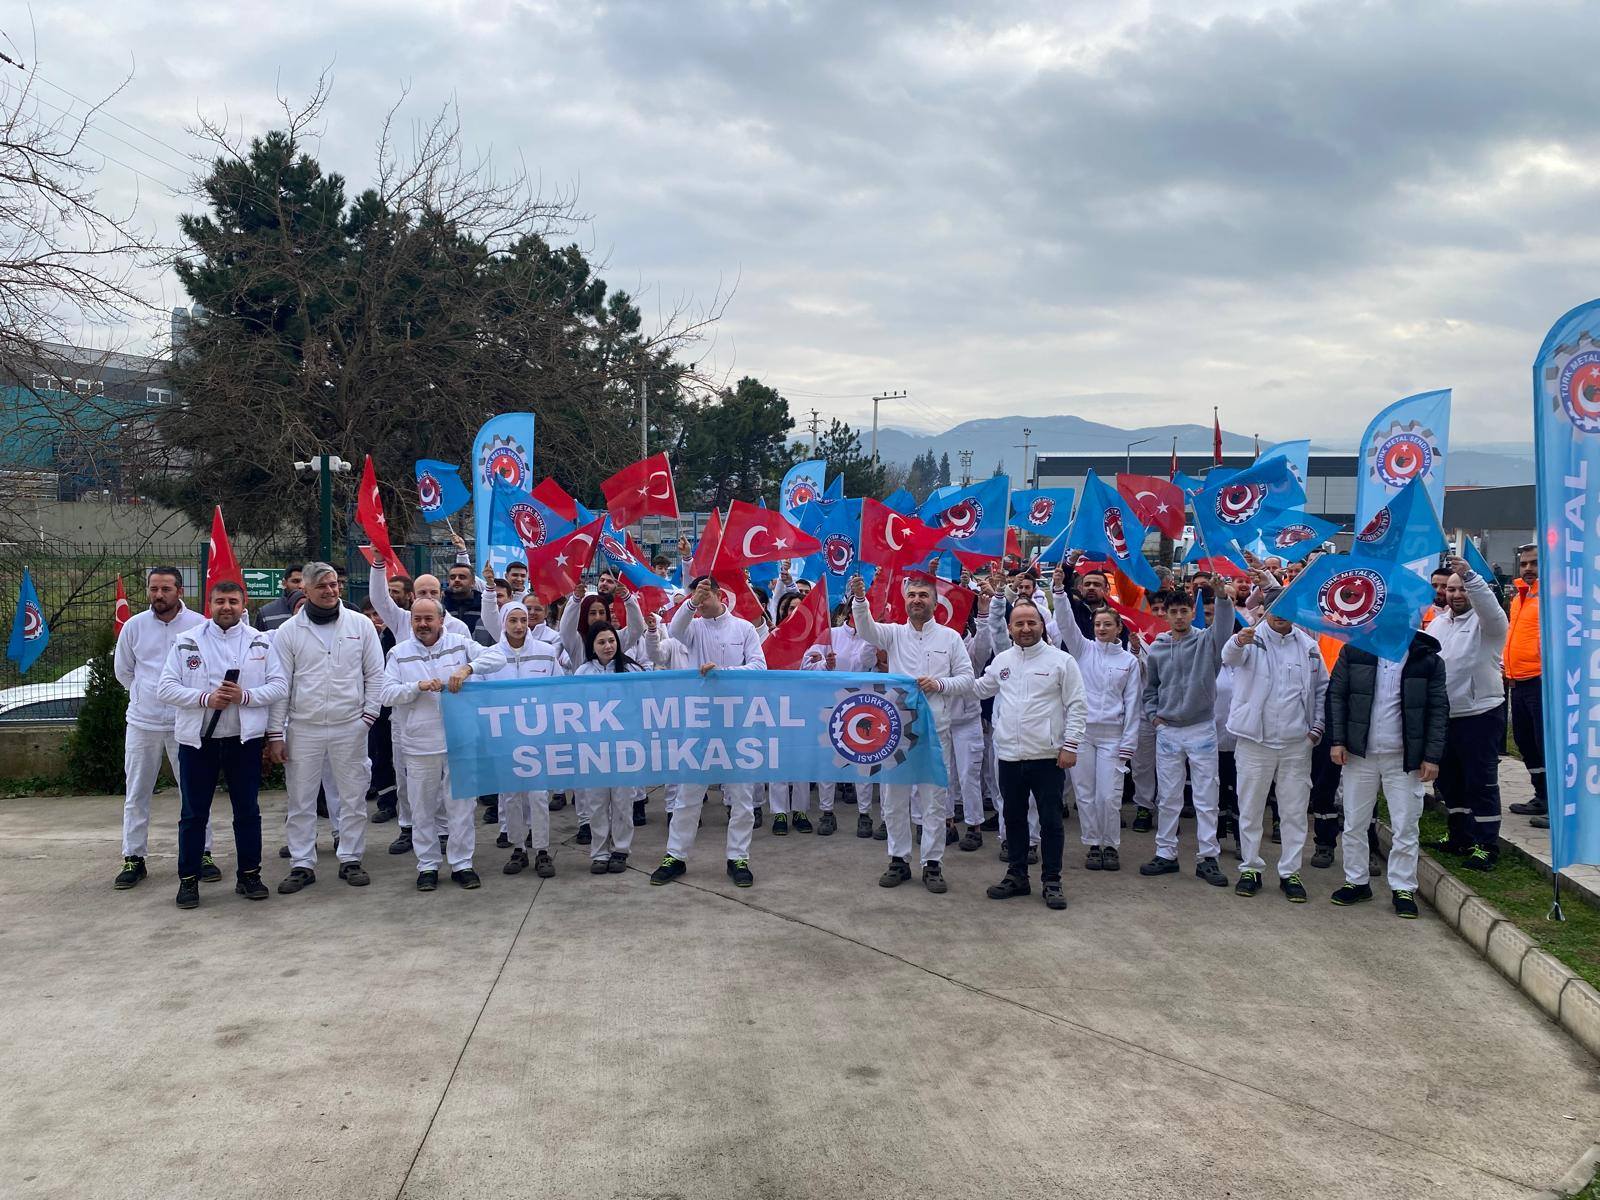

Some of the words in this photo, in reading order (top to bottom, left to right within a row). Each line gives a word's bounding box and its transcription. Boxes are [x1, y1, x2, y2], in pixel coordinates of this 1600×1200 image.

[1570, 354, 1600, 371] METAL
[1386, 435, 1409, 449] METAL
[491, 449, 507, 459] METAL
[1565, 460, 1588, 647] METAL
[1341, 570, 1367, 578] METAL
[859, 695, 884, 707] TÜRK
[478, 697, 624, 737] TÜRK
[641, 695, 806, 730] METAL
[883, 703, 899, 732] METAL
[512, 731, 779, 778] SENDİKASI
[857, 733, 898, 763] SENDİKASI
